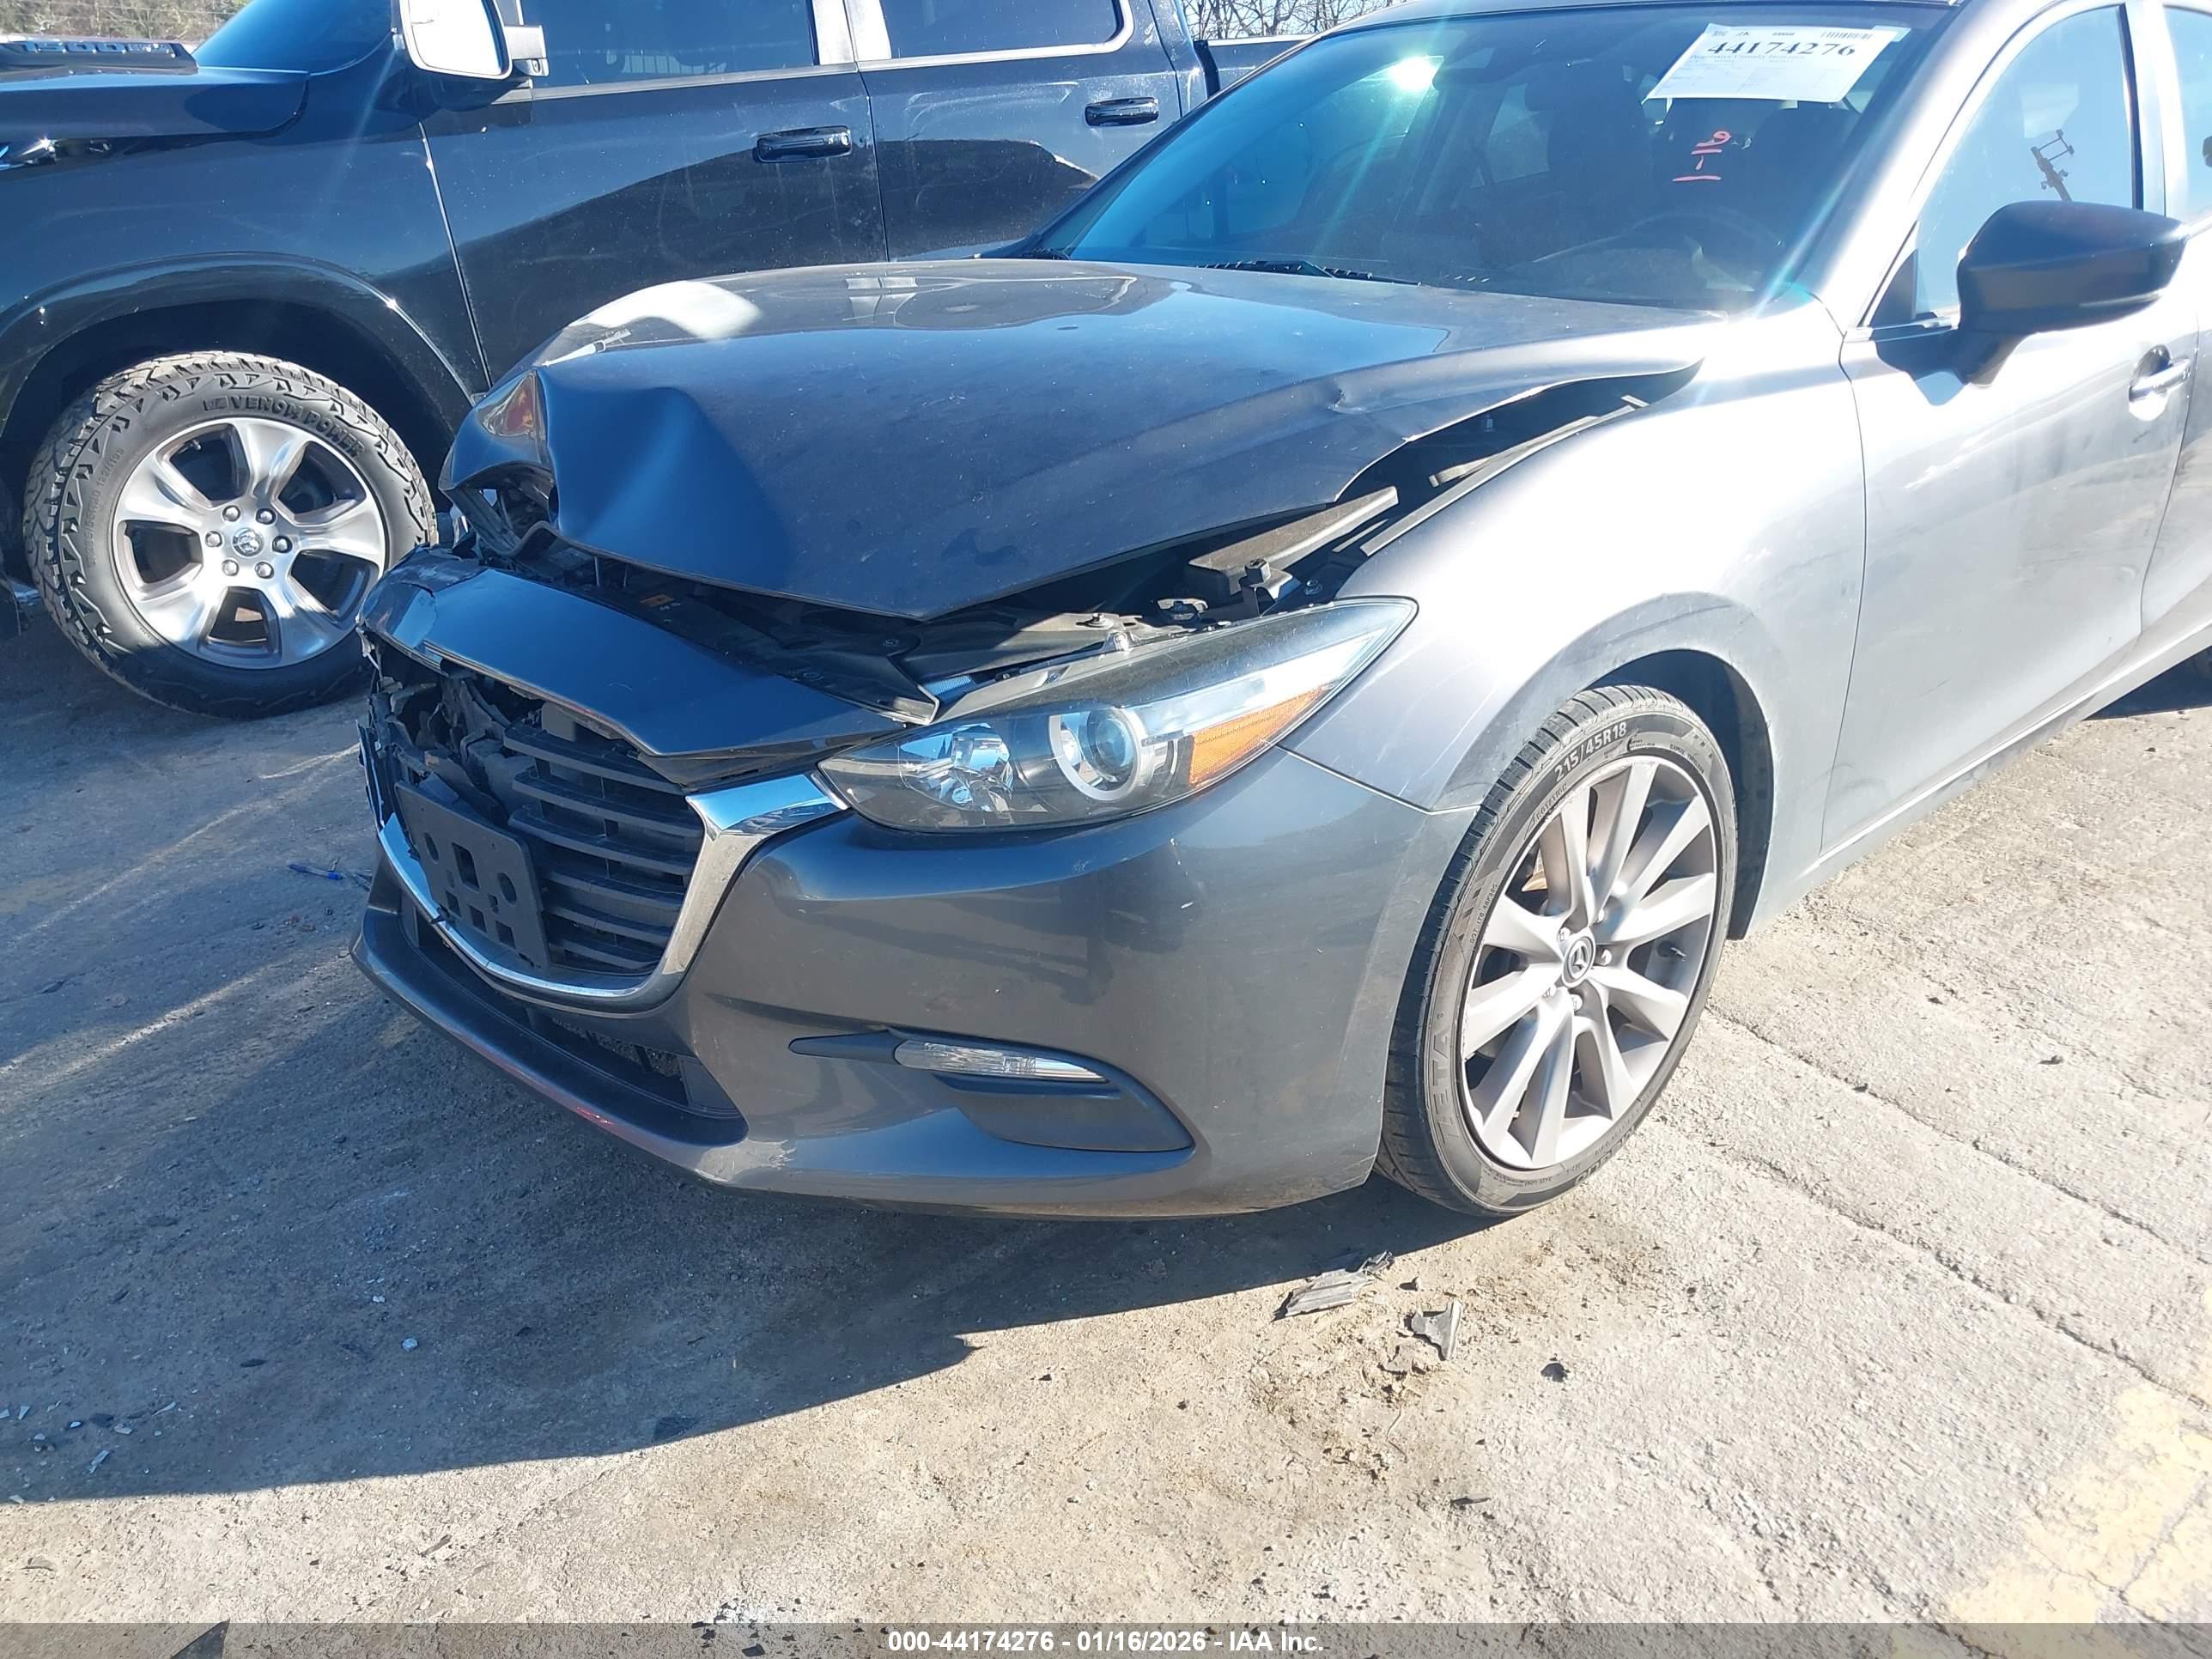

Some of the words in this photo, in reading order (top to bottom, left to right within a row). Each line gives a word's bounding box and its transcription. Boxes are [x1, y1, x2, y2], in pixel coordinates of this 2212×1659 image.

[1708, 41, 1856, 56] 44174276
[231, 395, 304, 420] VENOM
[303, 410, 365, 459] POWER
[1554, 722, 1627, 782] 215/45R18
